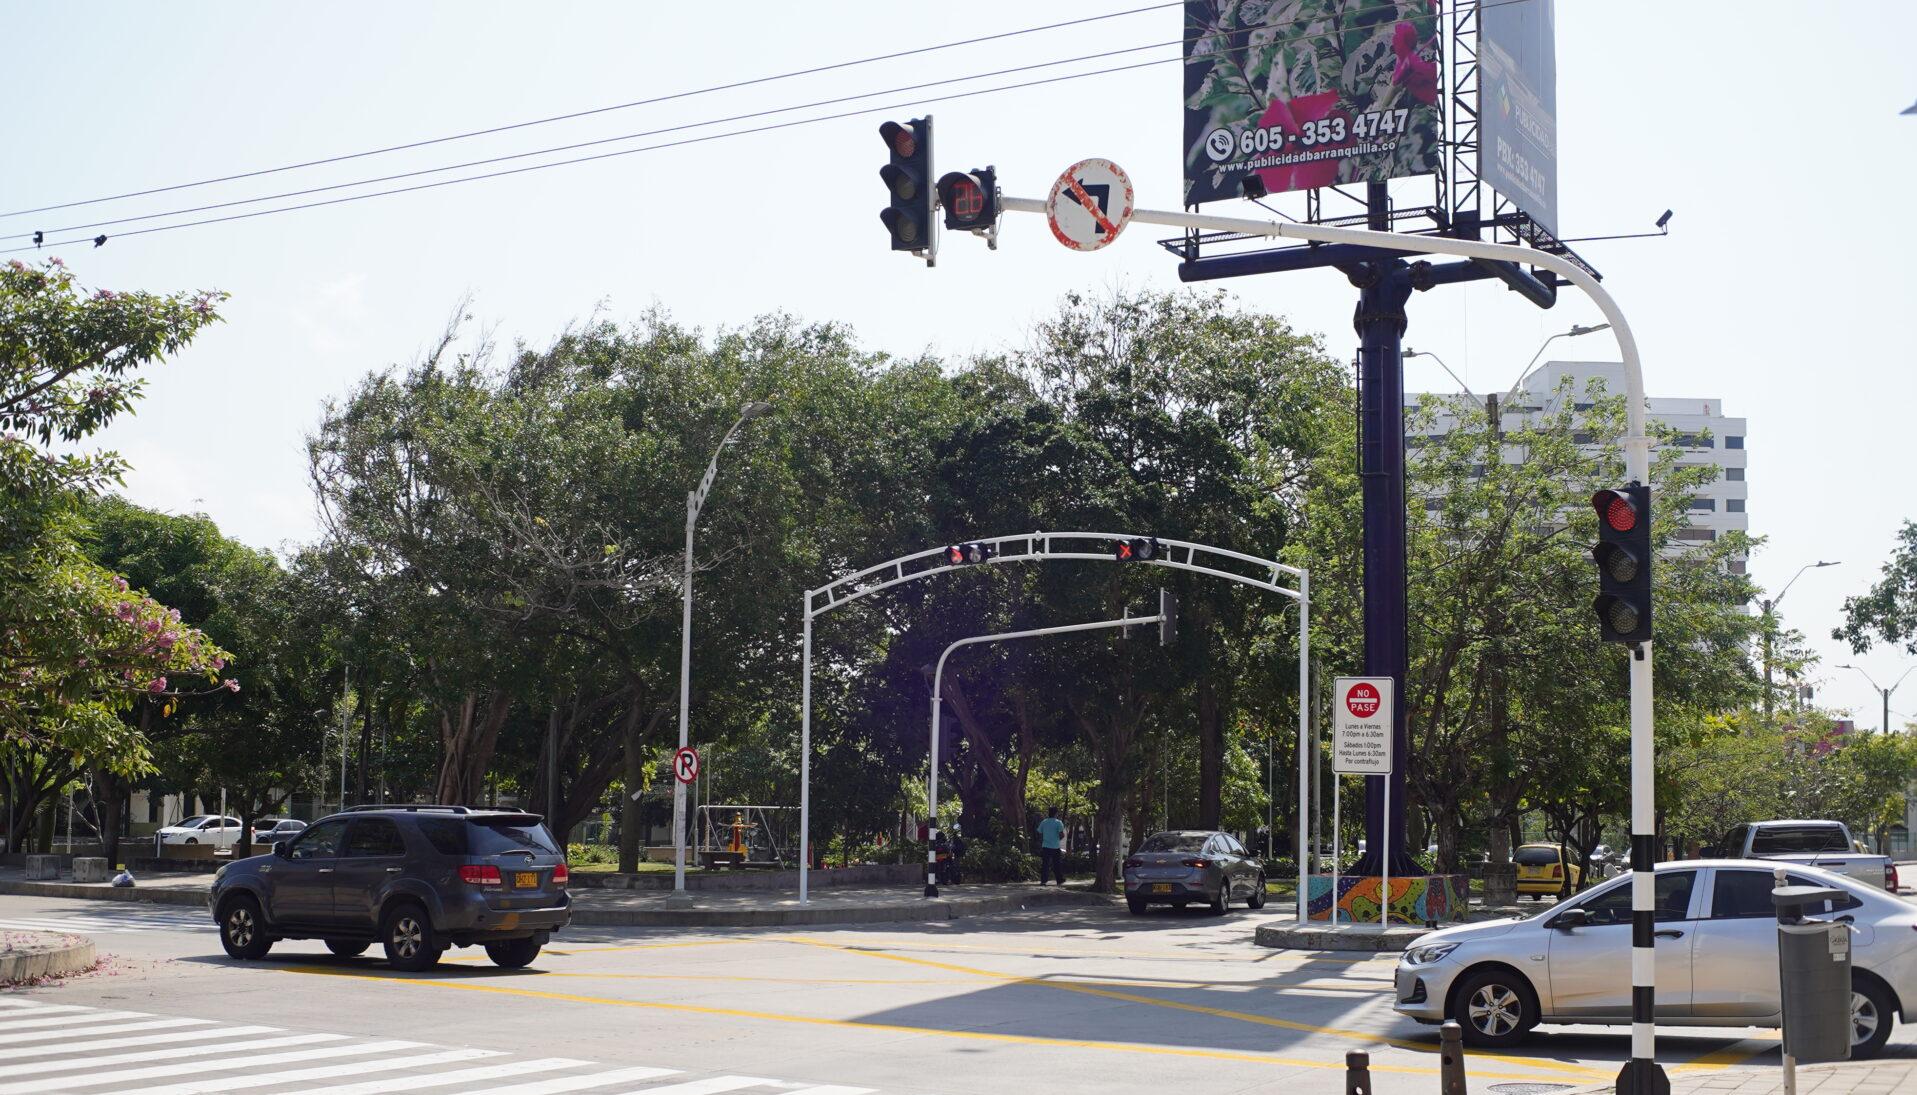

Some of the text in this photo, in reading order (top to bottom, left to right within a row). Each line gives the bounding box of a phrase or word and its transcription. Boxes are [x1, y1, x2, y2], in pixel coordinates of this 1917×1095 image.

[1240, 126, 1283, 154] 605
[1301, 117, 1346, 145] 353
[1352, 108, 1409, 138] 4747
[1219, 141, 1396, 172] www.publicidadbarranquilla.co
[1515, 152, 1529, 183] 353
[1530, 165, 1545, 196] 4747
